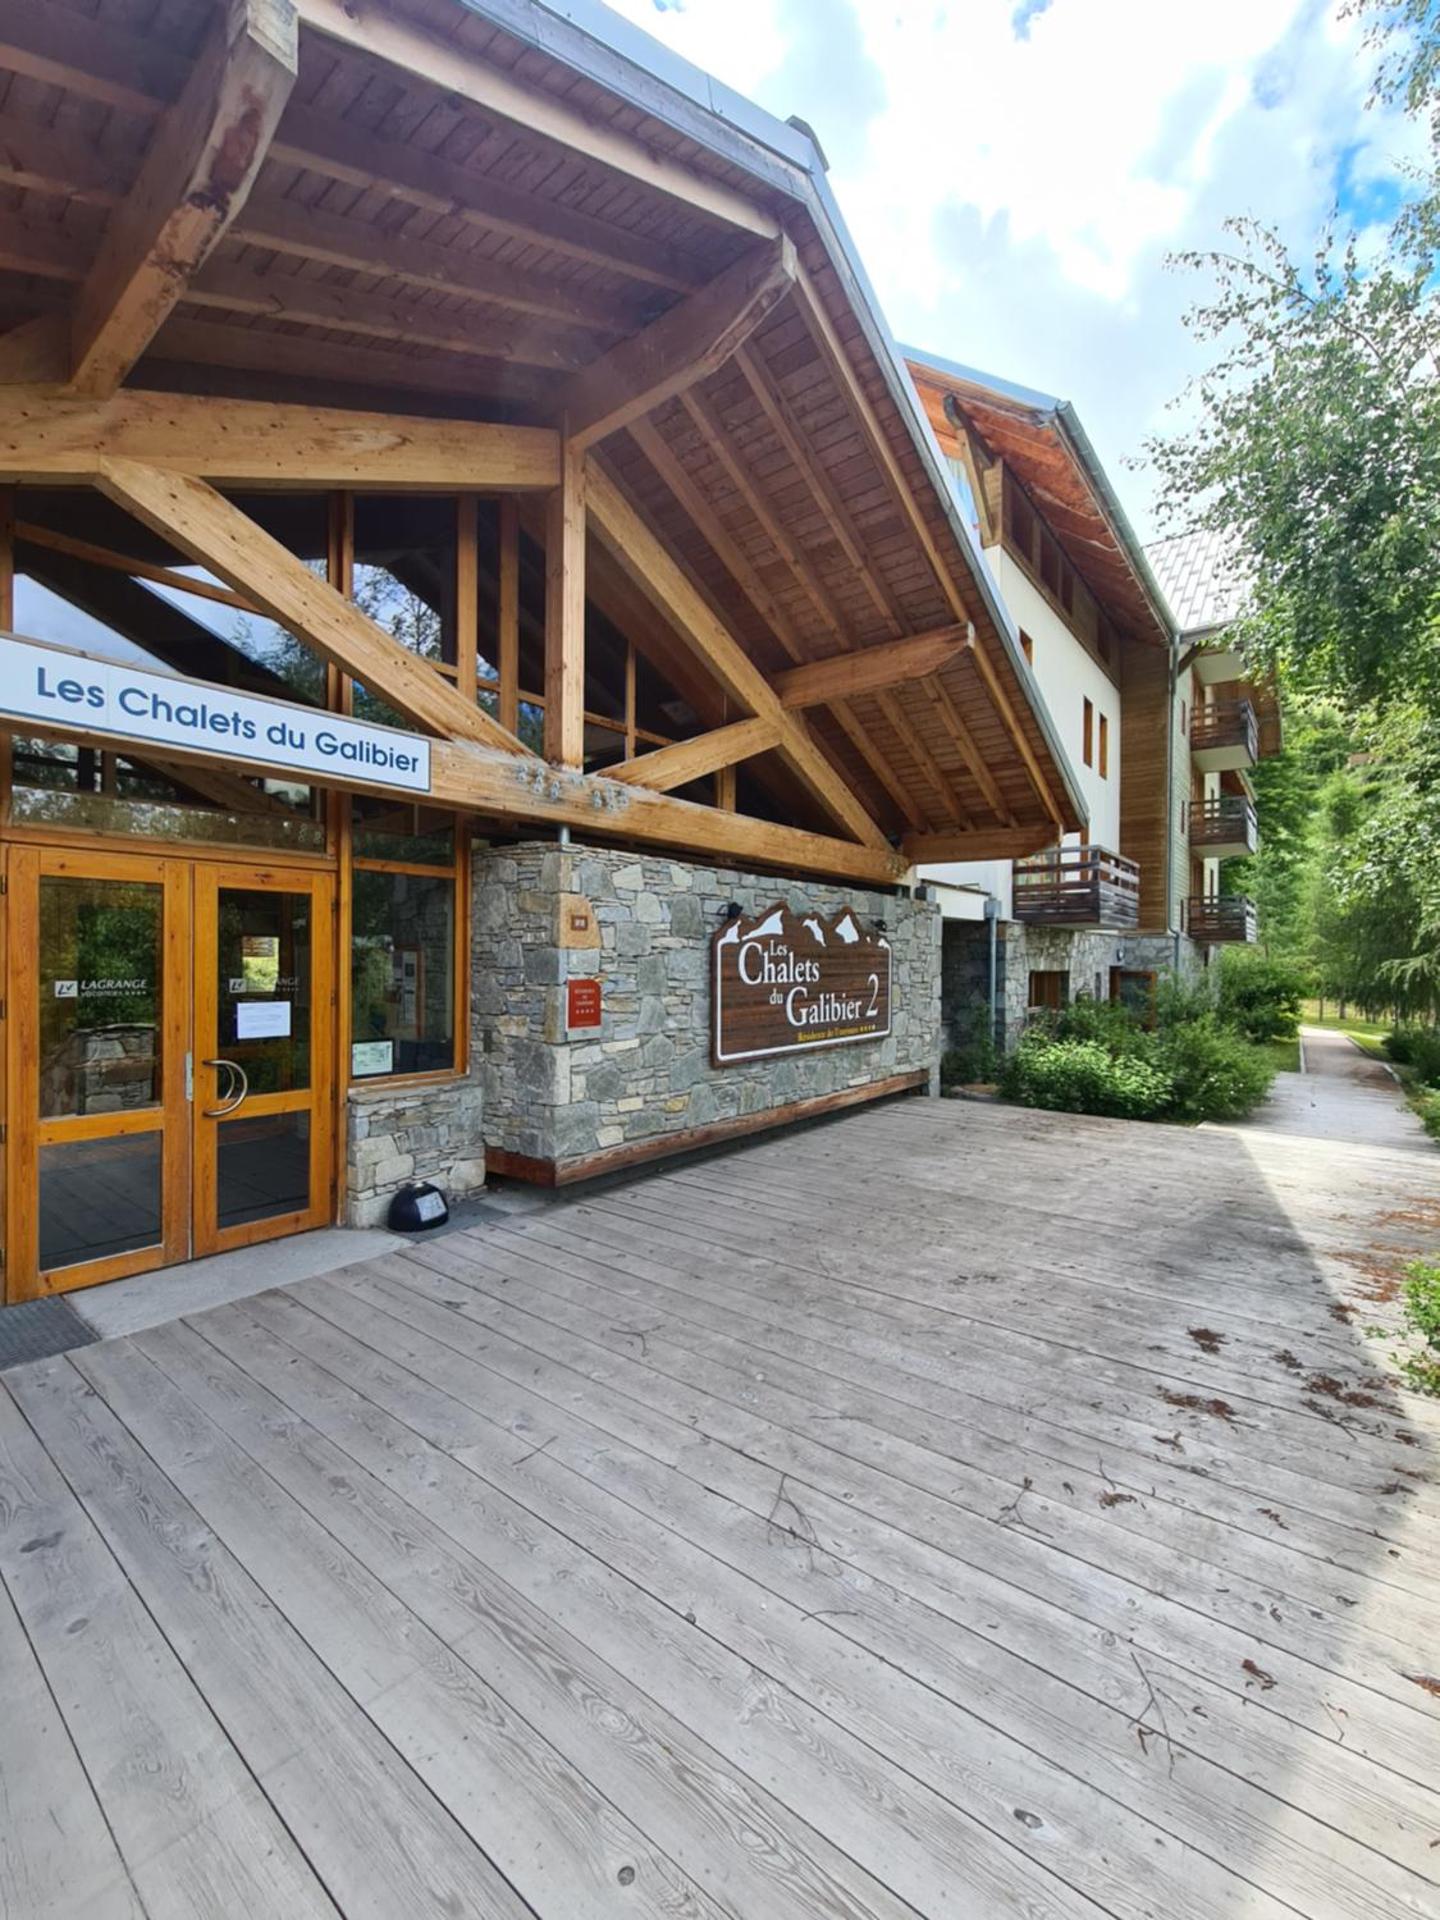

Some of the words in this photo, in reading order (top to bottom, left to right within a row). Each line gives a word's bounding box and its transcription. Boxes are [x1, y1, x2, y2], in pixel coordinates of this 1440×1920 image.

[37, 666, 105, 708] Les
[118, 687, 257, 739] Chalets
[266, 722, 305, 750] du
[315, 732, 419, 773] Galibier
[738, 941, 820, 985] Chalets
[769, 939, 788, 957] Les
[80, 979, 148, 990] LAGRANGE
[769, 988, 784, 1005] du
[786, 986, 863, 1027] Galibier
[865, 973, 880, 1018] 2
